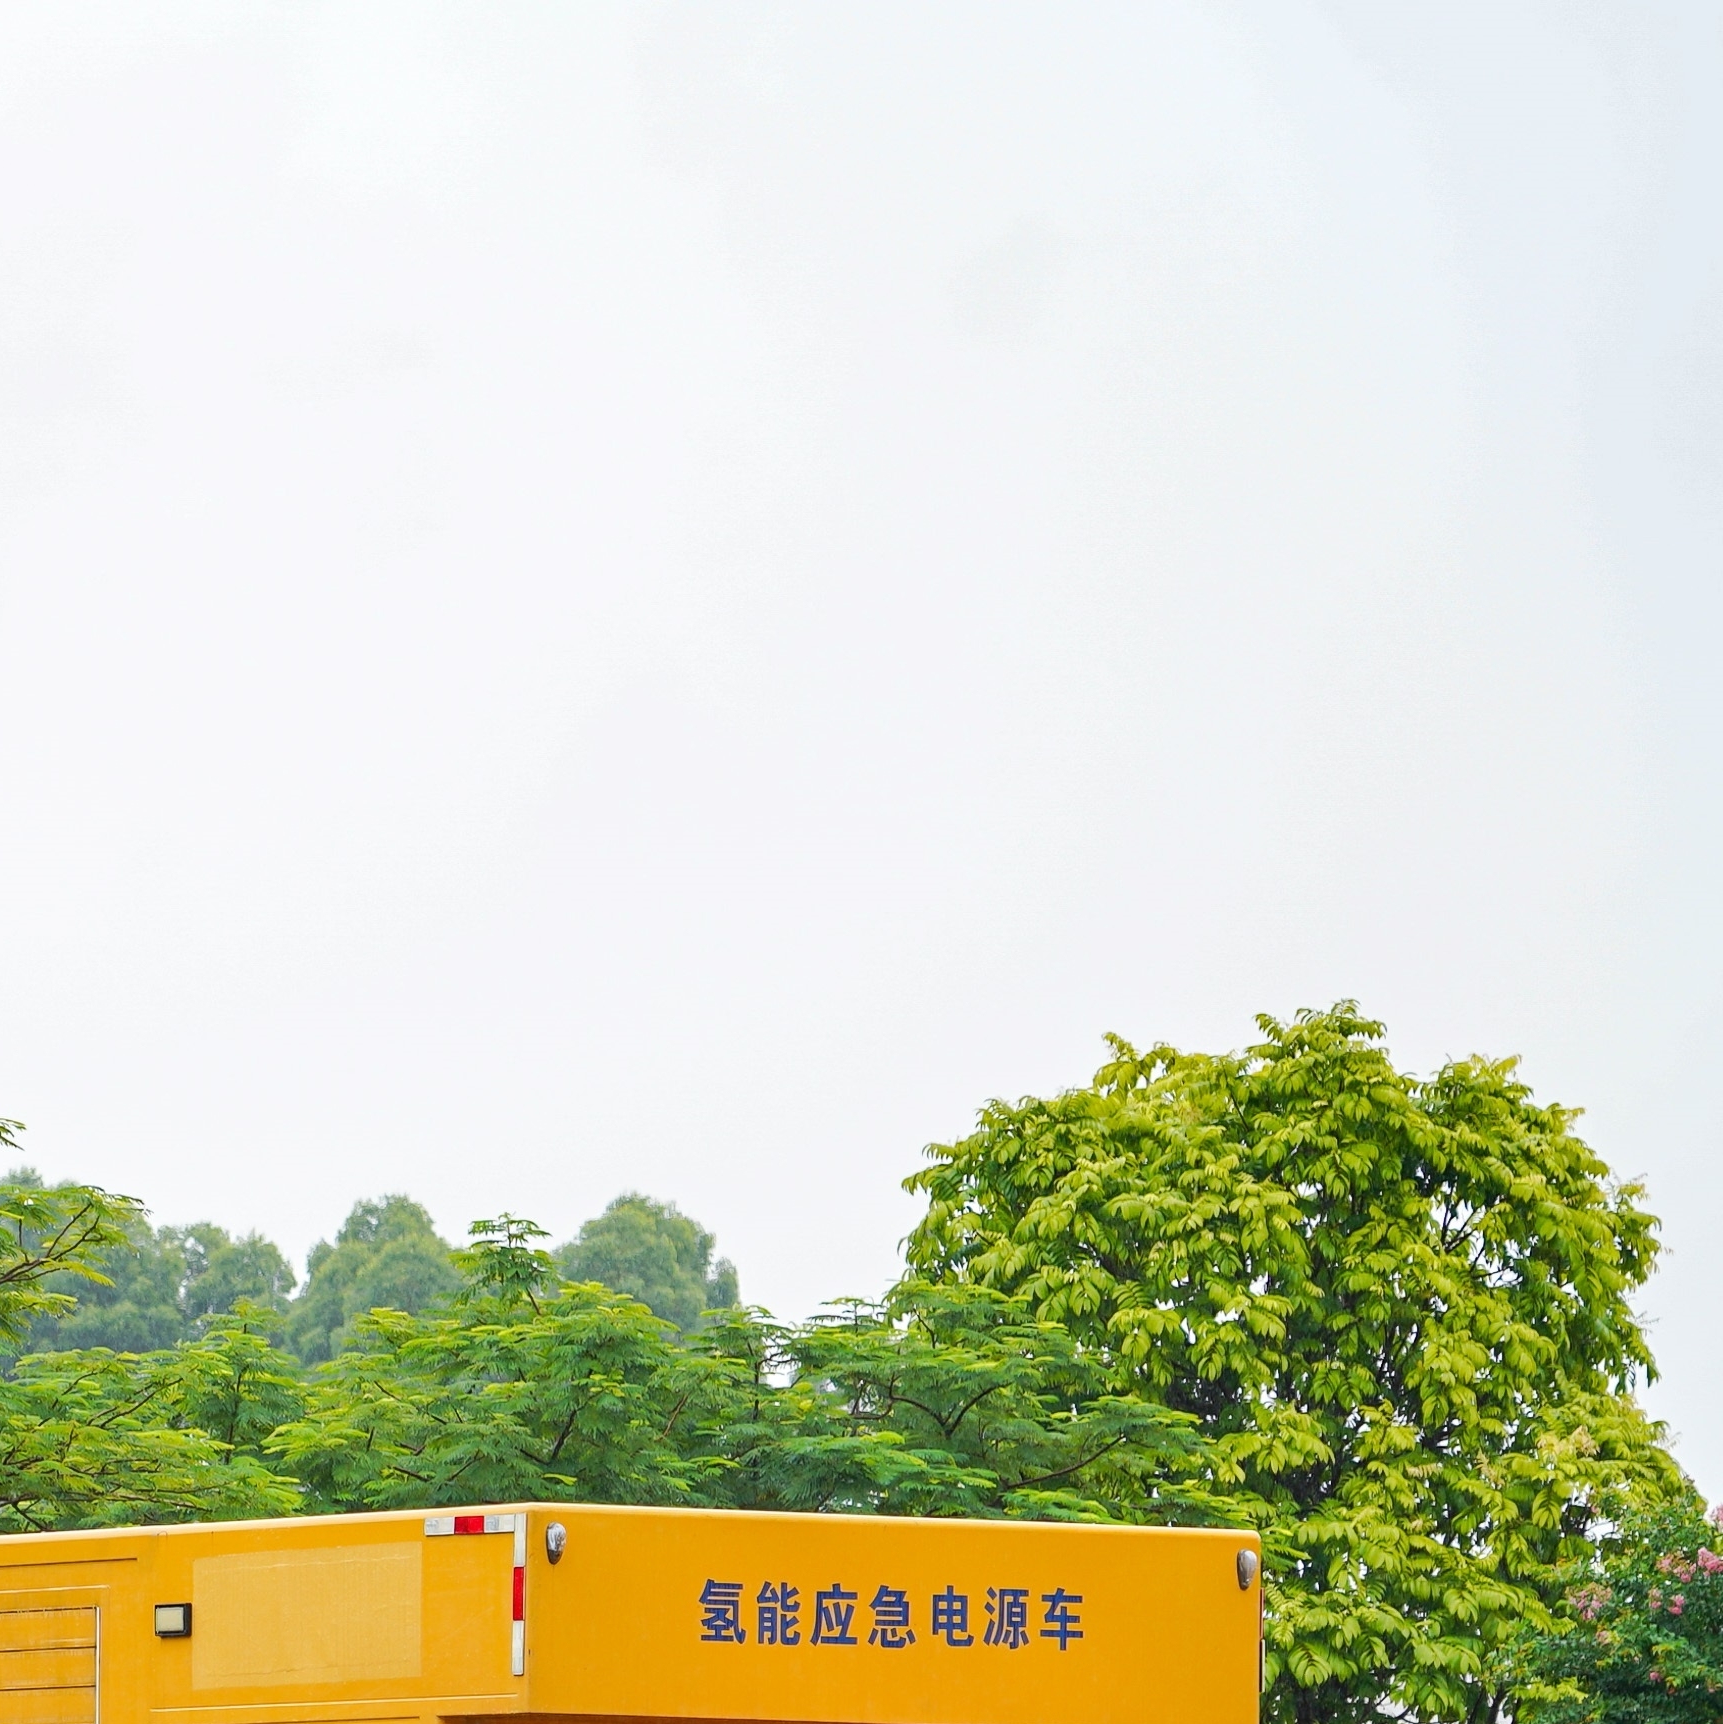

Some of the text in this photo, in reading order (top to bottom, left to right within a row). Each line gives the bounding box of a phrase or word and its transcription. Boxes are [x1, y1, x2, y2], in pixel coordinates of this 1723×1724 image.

[698, 1579, 1084, 1652] 氢能应急电源车
